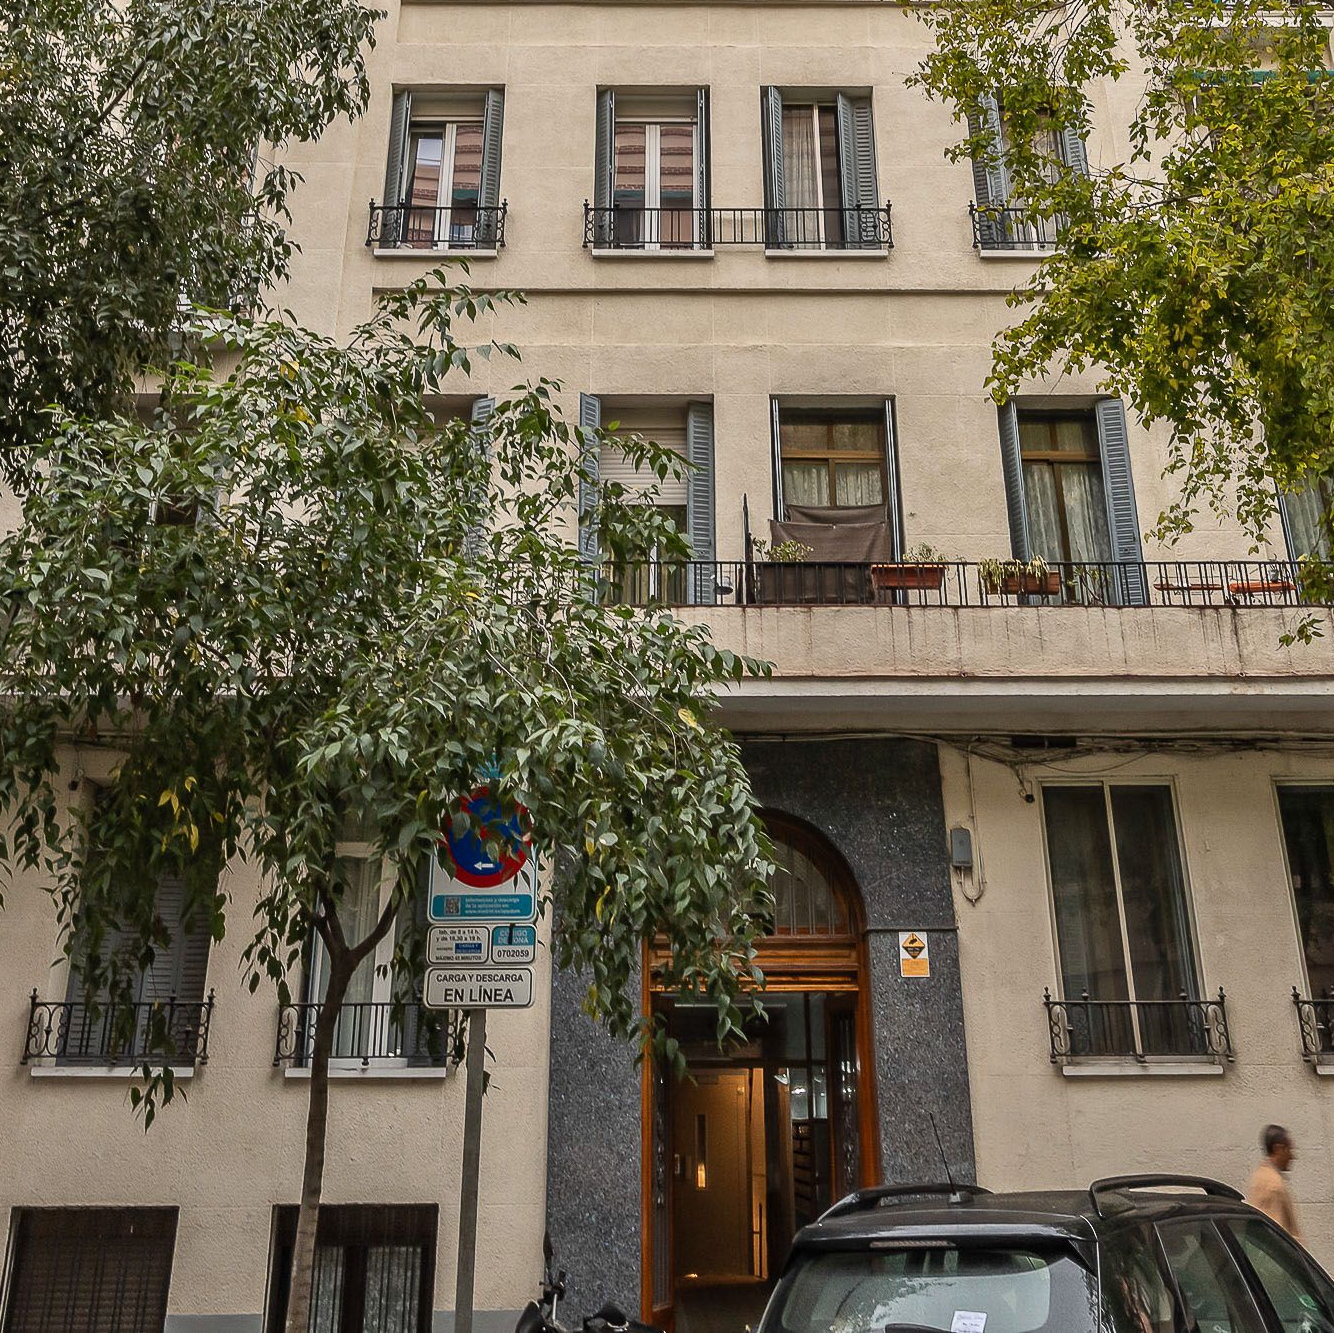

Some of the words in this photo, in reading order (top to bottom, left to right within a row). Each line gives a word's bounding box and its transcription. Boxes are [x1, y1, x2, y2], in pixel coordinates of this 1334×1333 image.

[497, 949, 529, 958] 0702059
[436, 973, 467, 982] CARGA
[467, 973, 474, 982] Y
[475, 973, 524, 983] DESCARGA
[443, 988, 465, 1003] EN
[469, 984, 515, 1003] LÍNEA
